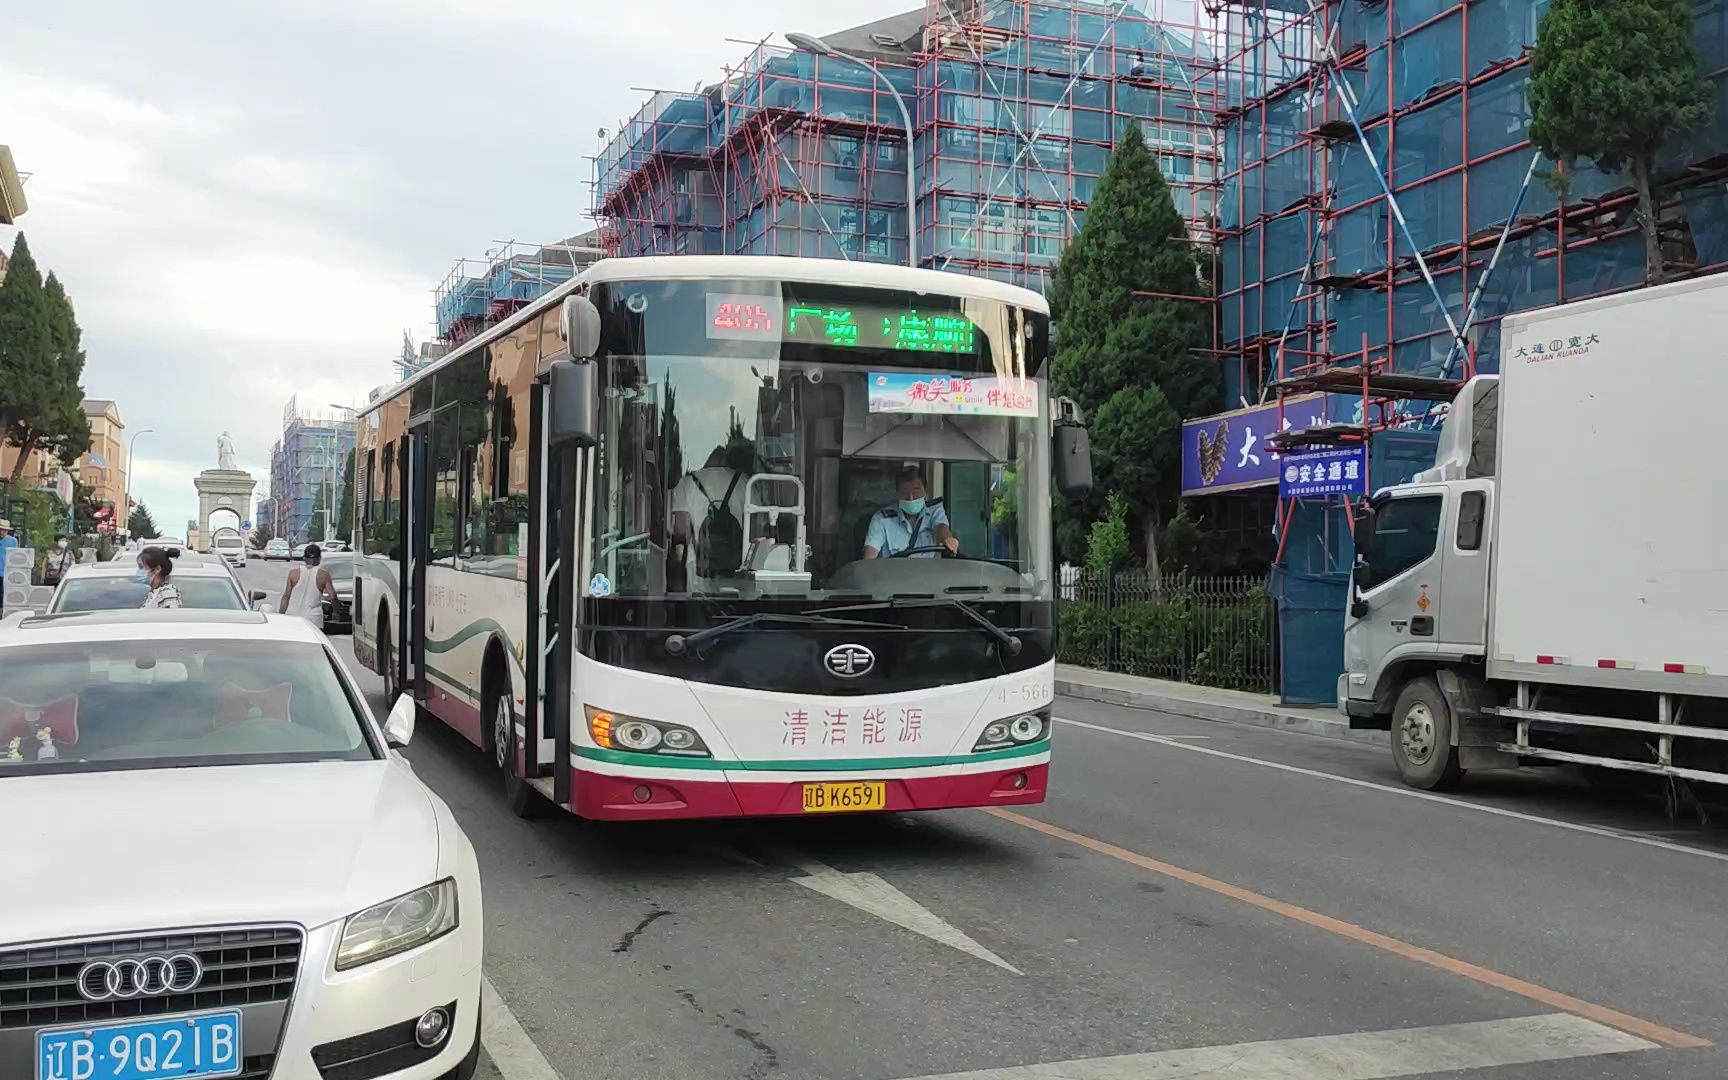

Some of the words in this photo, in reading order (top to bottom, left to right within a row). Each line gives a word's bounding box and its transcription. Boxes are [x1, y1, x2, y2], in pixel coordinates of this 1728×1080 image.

[1514, 343, 1545, 359] 大连
[1526, 353, 1554, 364] DALIAN
[1556, 346, 1590, 359] KUANDA
[1299, 459, 1360, 484] 安全通道
[781, 707, 924, 746] 清洁能源
